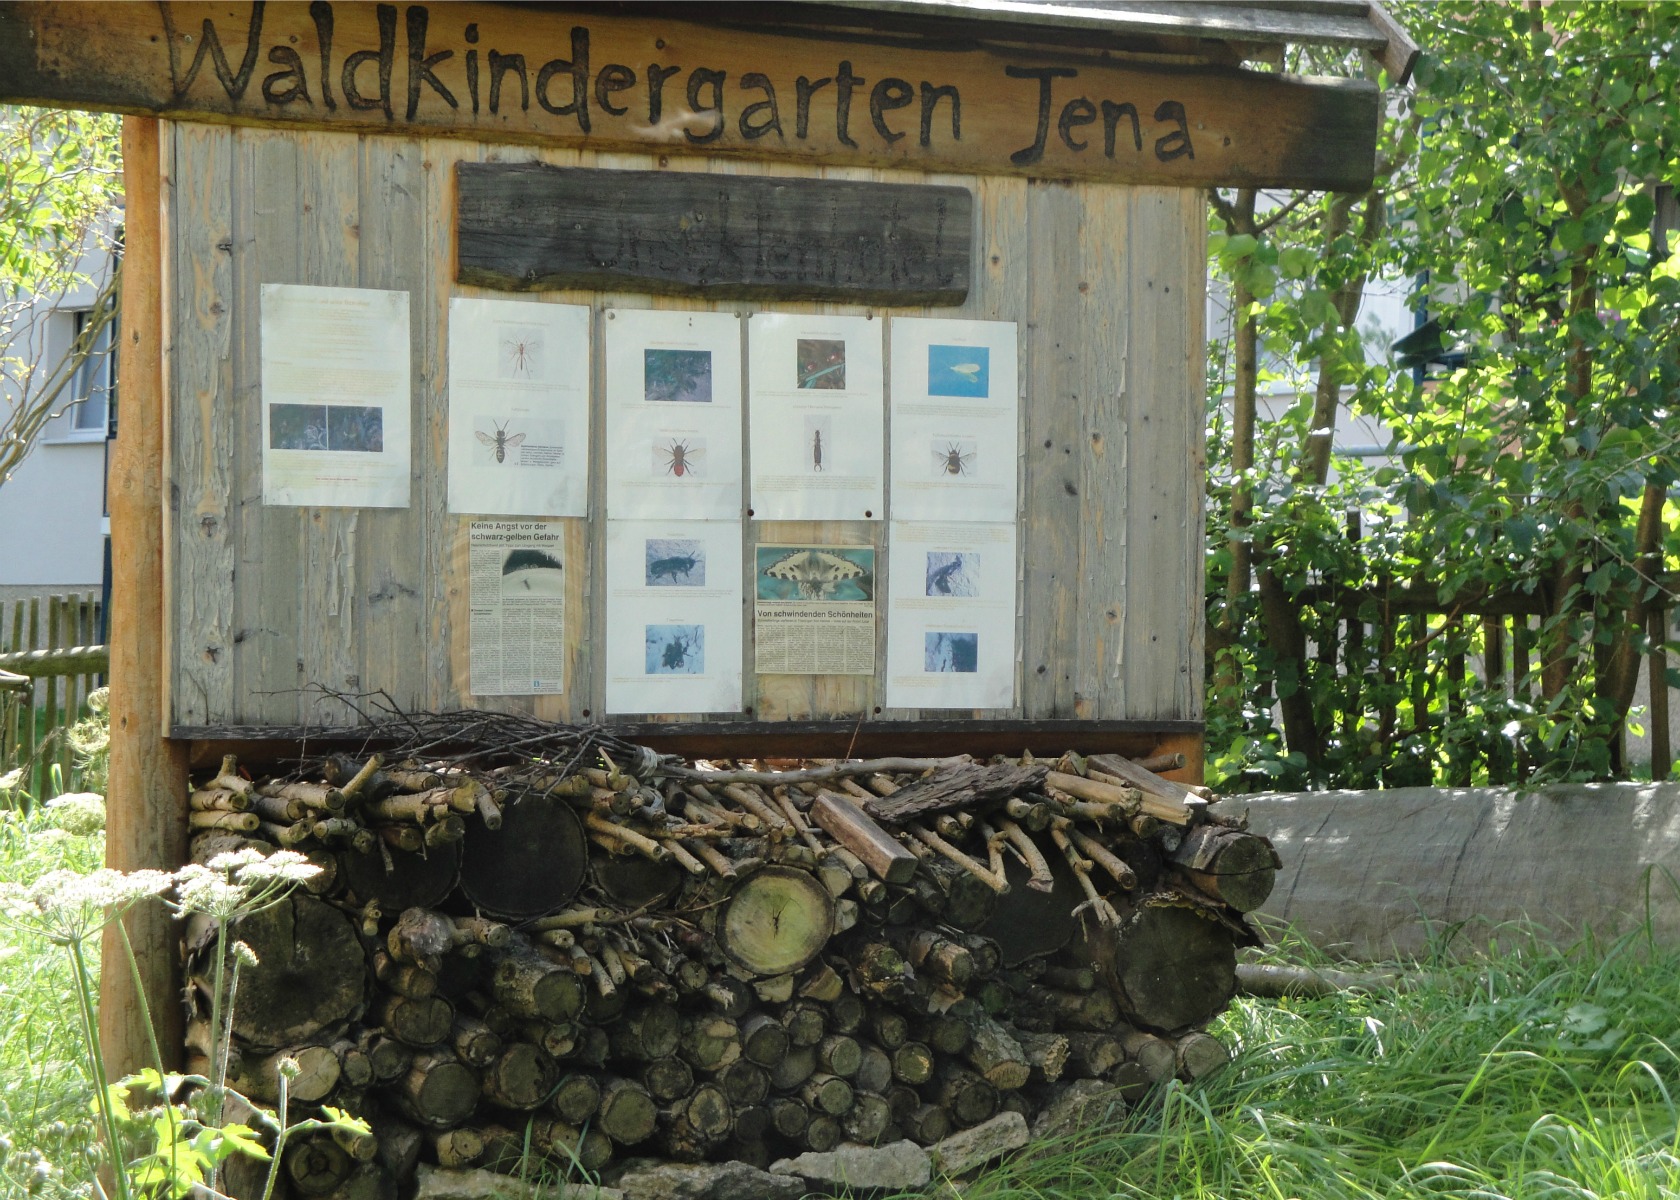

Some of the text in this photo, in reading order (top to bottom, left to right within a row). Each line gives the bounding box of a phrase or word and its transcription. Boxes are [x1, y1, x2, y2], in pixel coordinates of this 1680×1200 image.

[160, 2, 1195, 167] Waldkindergarten Jena
[471, 522, 493, 530] Keine
[495, 522, 518, 531] Angst
[471, 533, 560, 542] schwarz-gelben Gefahr
[757, 609, 873, 618] Von schwindenden Schönheiten
